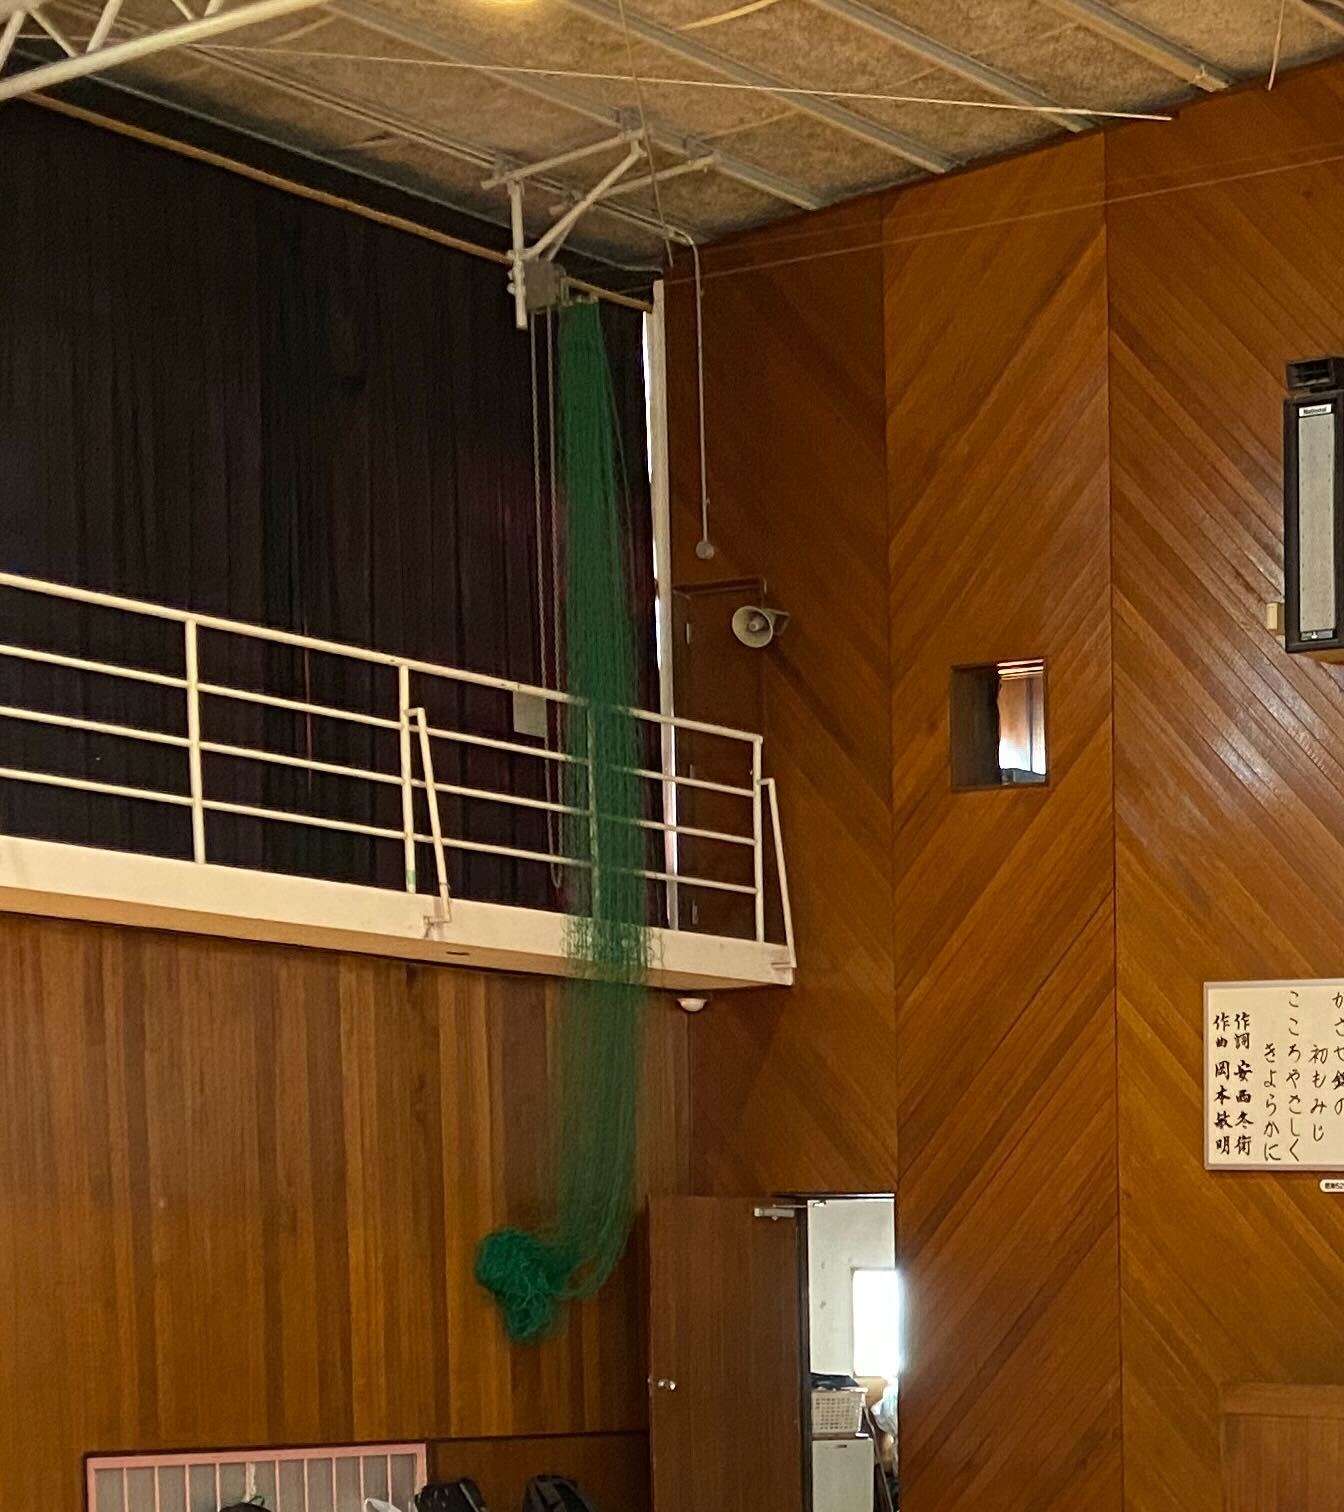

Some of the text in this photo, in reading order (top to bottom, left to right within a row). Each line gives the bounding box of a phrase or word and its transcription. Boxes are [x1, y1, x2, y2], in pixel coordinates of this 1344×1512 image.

[1263, 1043, 1281, 1162] きよらかに
[1286, 990, 1301, 1162] こころやさしく
[1307, 1044, 1329, 1142] 初もみじ
